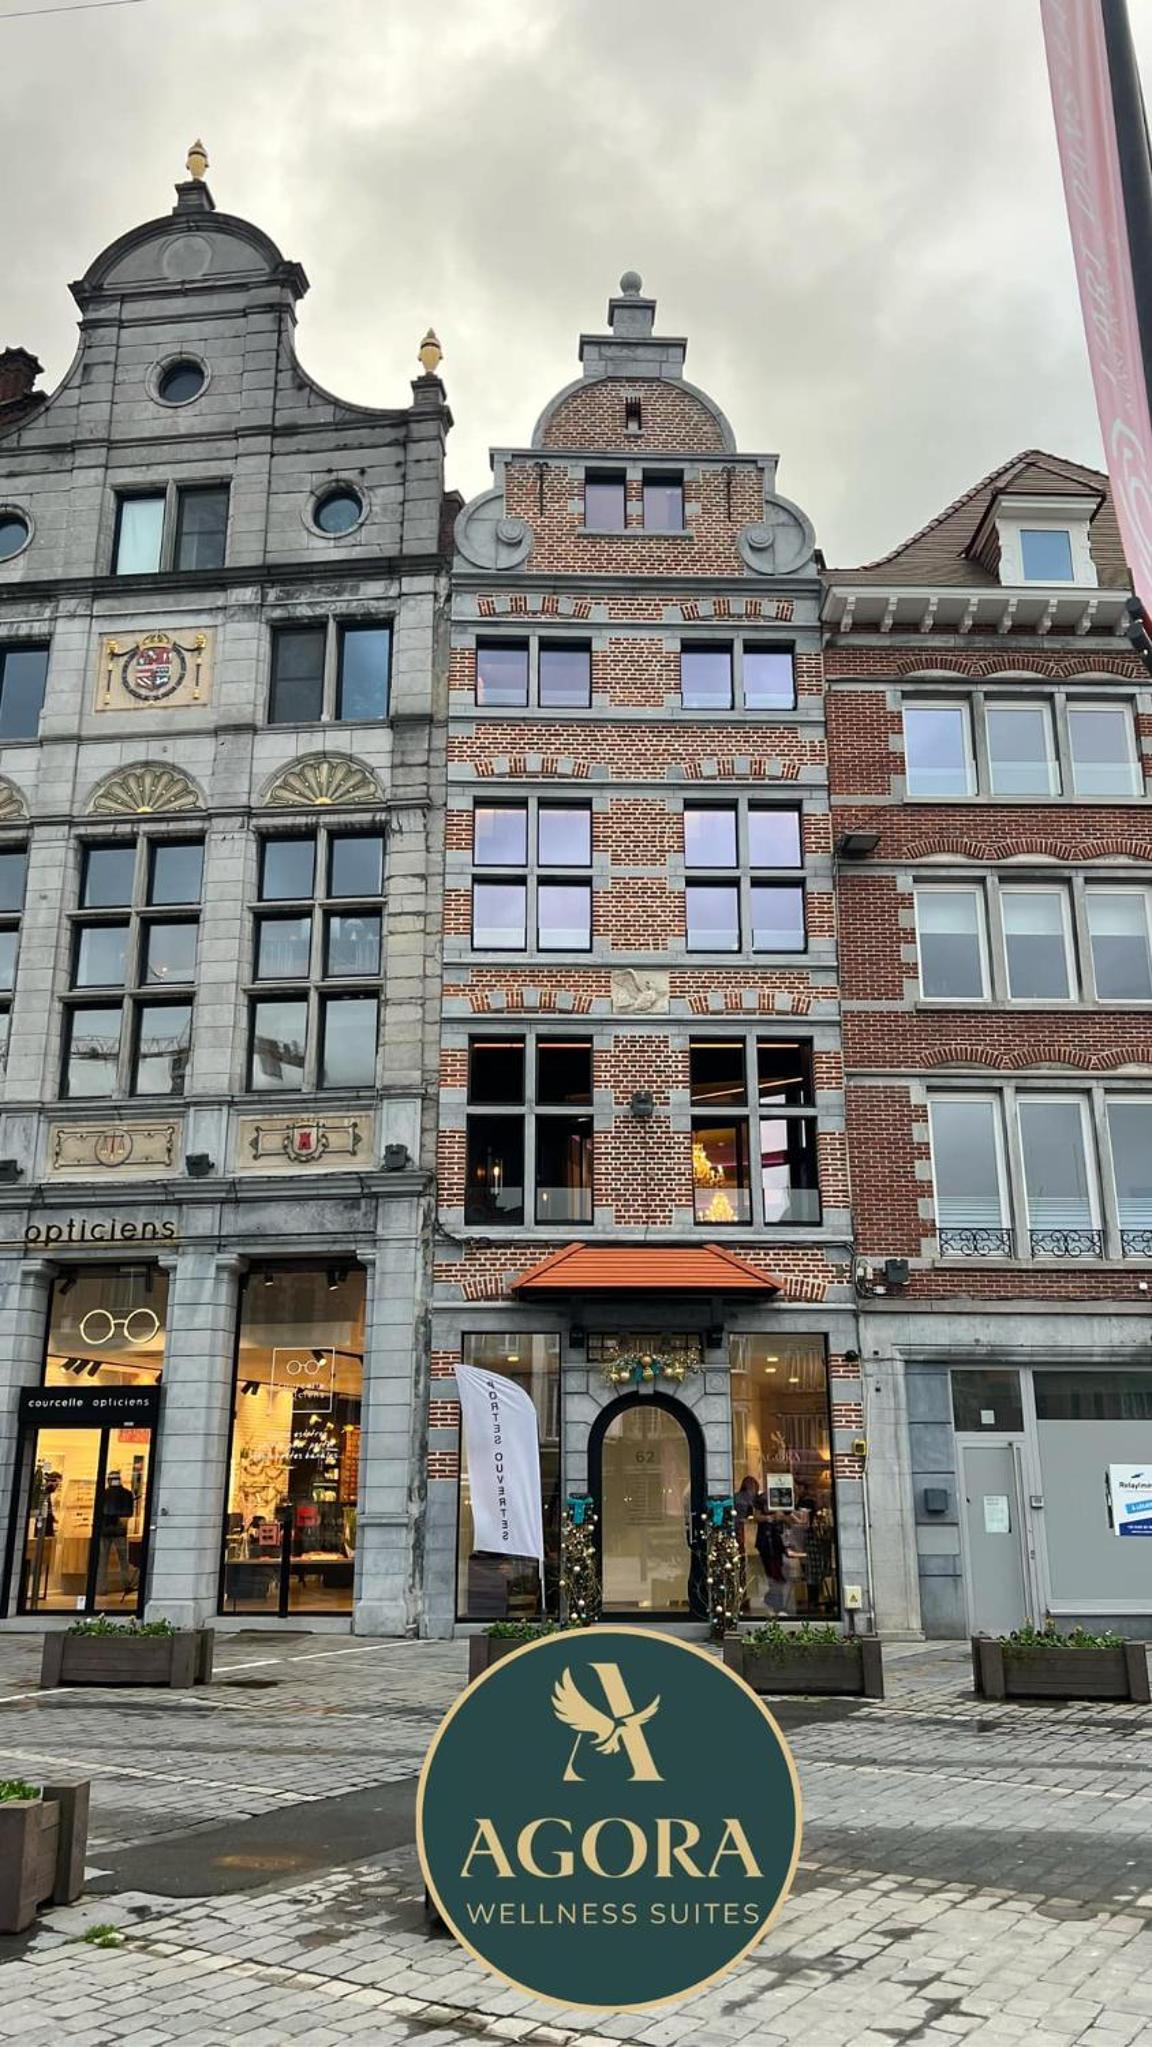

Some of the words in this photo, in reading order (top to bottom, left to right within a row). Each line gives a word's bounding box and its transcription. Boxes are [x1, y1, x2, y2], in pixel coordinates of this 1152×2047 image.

[25, 1218, 175, 1247] opticiens
[28, 1397, 83, 1408] courcelle
[92, 1396, 150, 1408] opticiens
[635, 1450, 655, 1463] 62
